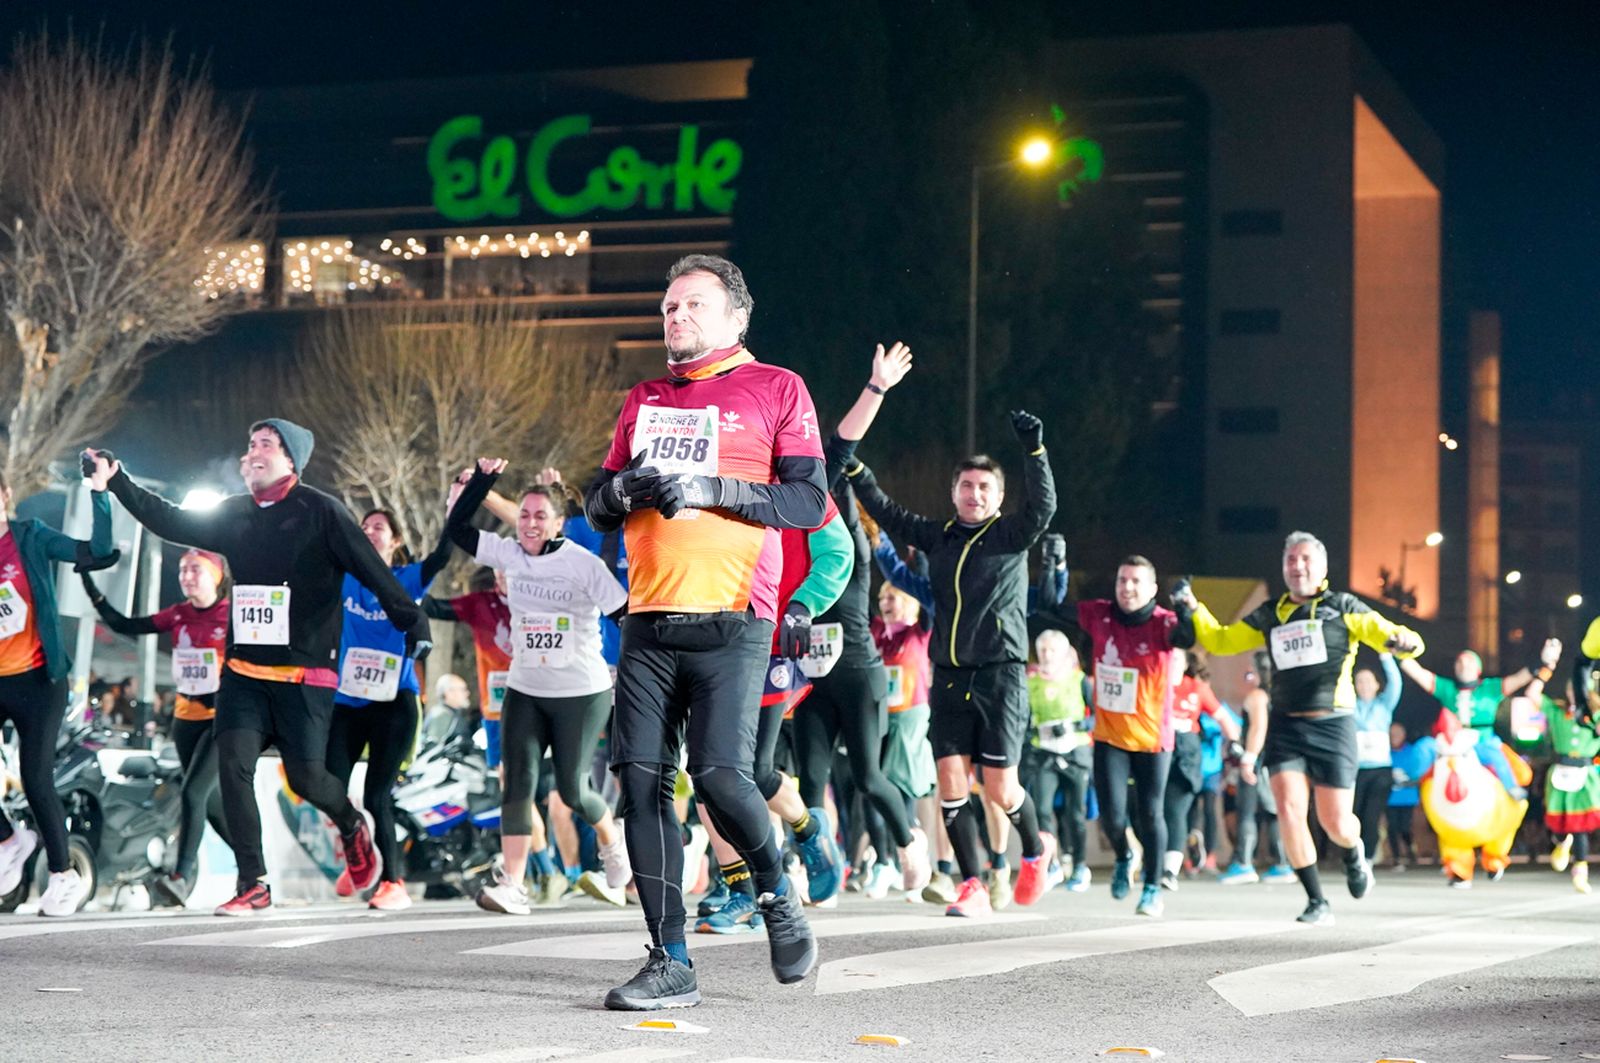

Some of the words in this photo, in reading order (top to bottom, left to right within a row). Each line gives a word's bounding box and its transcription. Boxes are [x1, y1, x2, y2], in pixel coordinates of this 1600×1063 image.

[427, 115, 521, 221] El
[526, 114, 743, 218] Corte
[645, 426, 664, 435] SAN
[687, 418, 700, 426] DE
[651, 436, 710, 463] 1958
[512, 580, 573, 601] SANTIAGO
[240, 606, 274, 625] 1419
[526, 632, 563, 650] 5232
[1282, 634, 1314, 653] 3073
[353, 665, 386, 684] 3471
